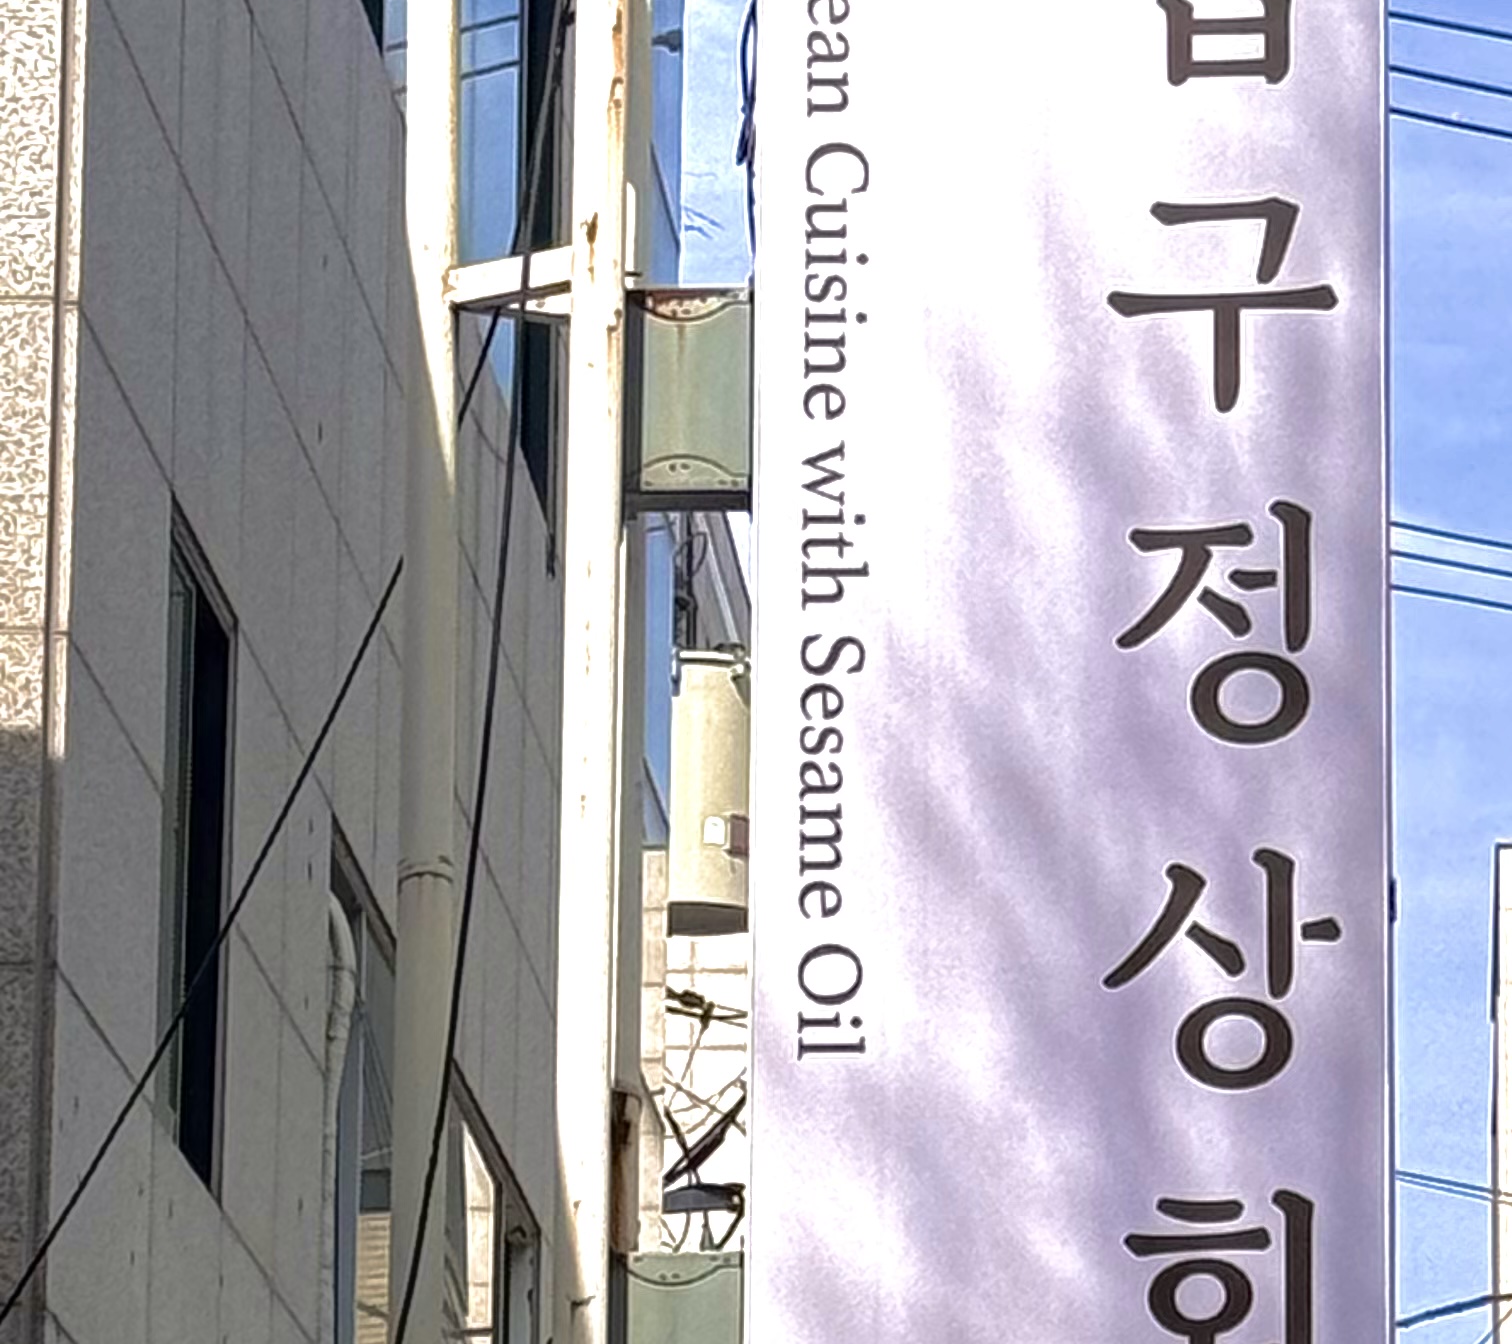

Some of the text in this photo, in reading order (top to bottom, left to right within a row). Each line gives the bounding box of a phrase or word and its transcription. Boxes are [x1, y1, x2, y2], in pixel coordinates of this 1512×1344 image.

[803, 142, 870, 420] Cuisine
[801, 442, 870, 609] with
[798, 634, 866, 919] Sesame
[796, 943, 866, 1061] Oil
